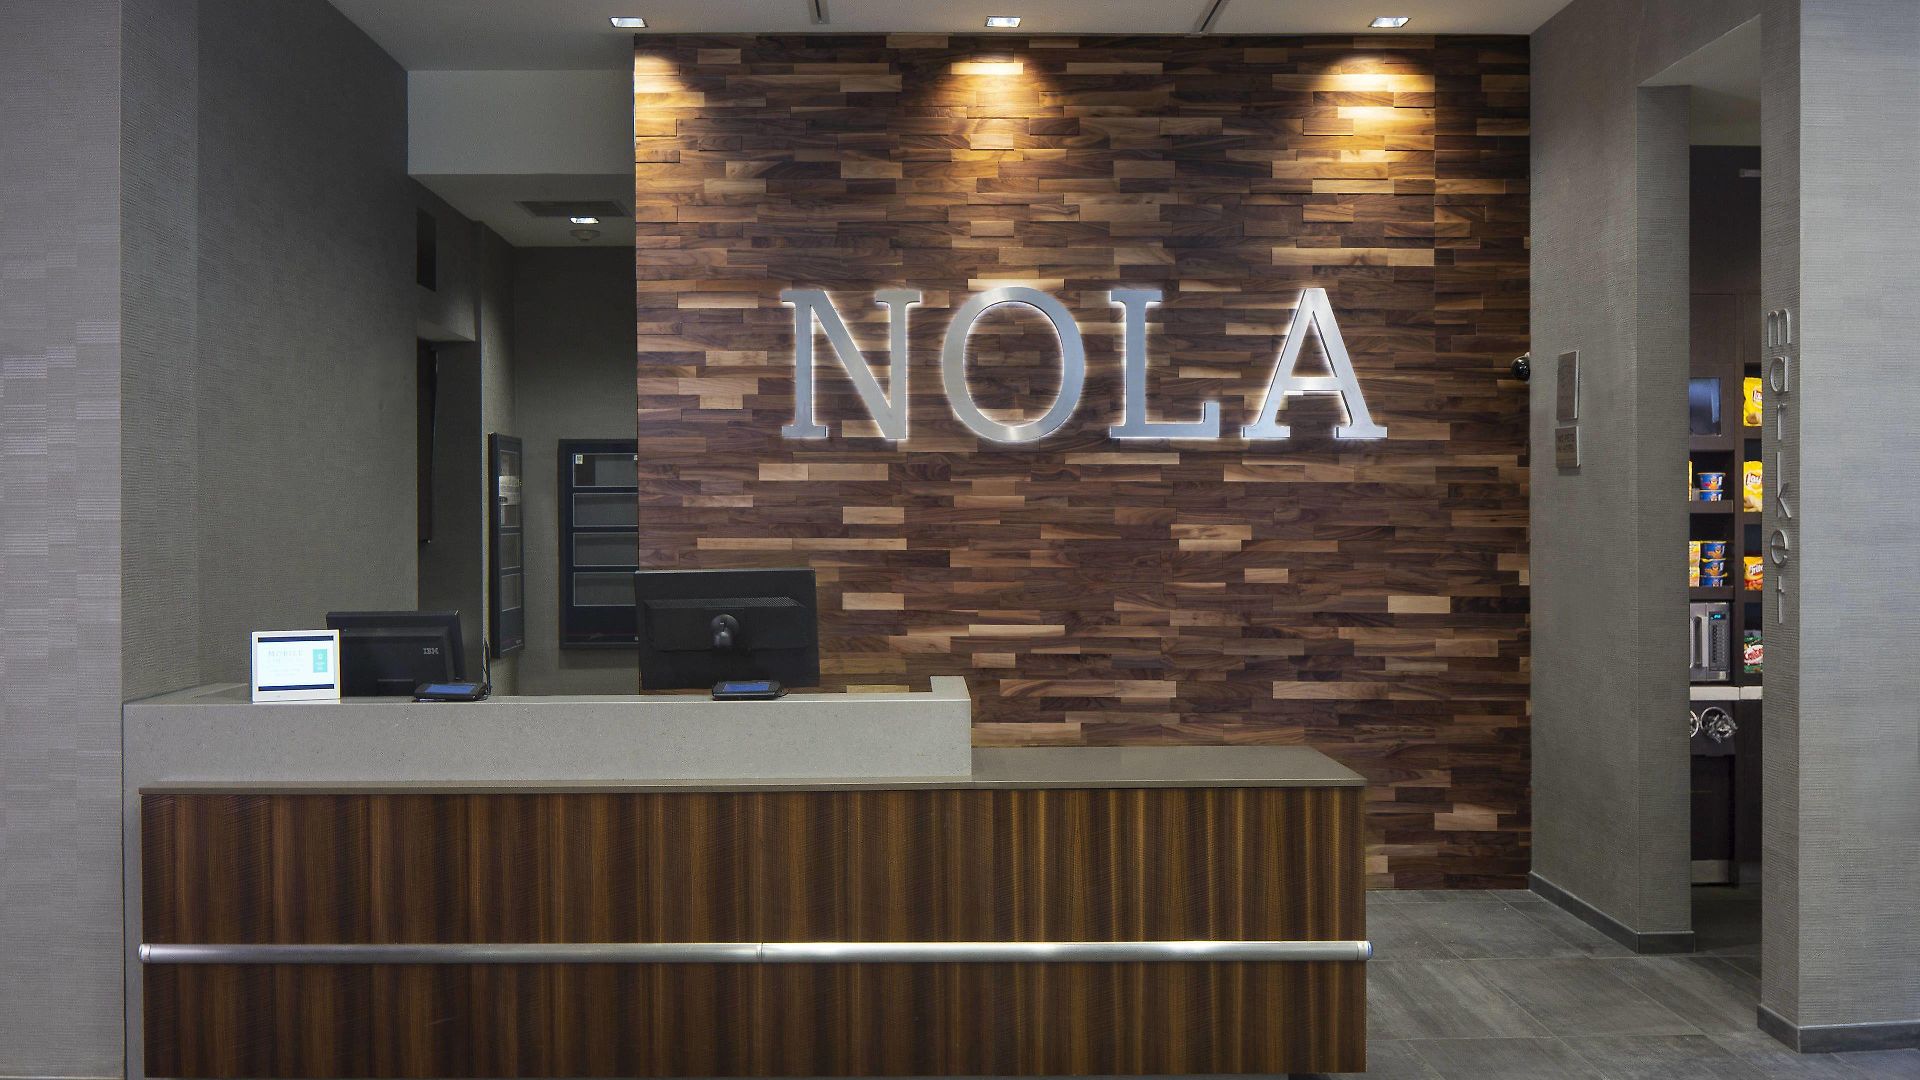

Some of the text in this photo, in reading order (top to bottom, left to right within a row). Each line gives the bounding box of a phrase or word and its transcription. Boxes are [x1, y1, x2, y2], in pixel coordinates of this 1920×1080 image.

[781, 286, 1389, 443] NOLA
[1767, 308, 1792, 624] market
[423, 647, 439, 655] IBM
